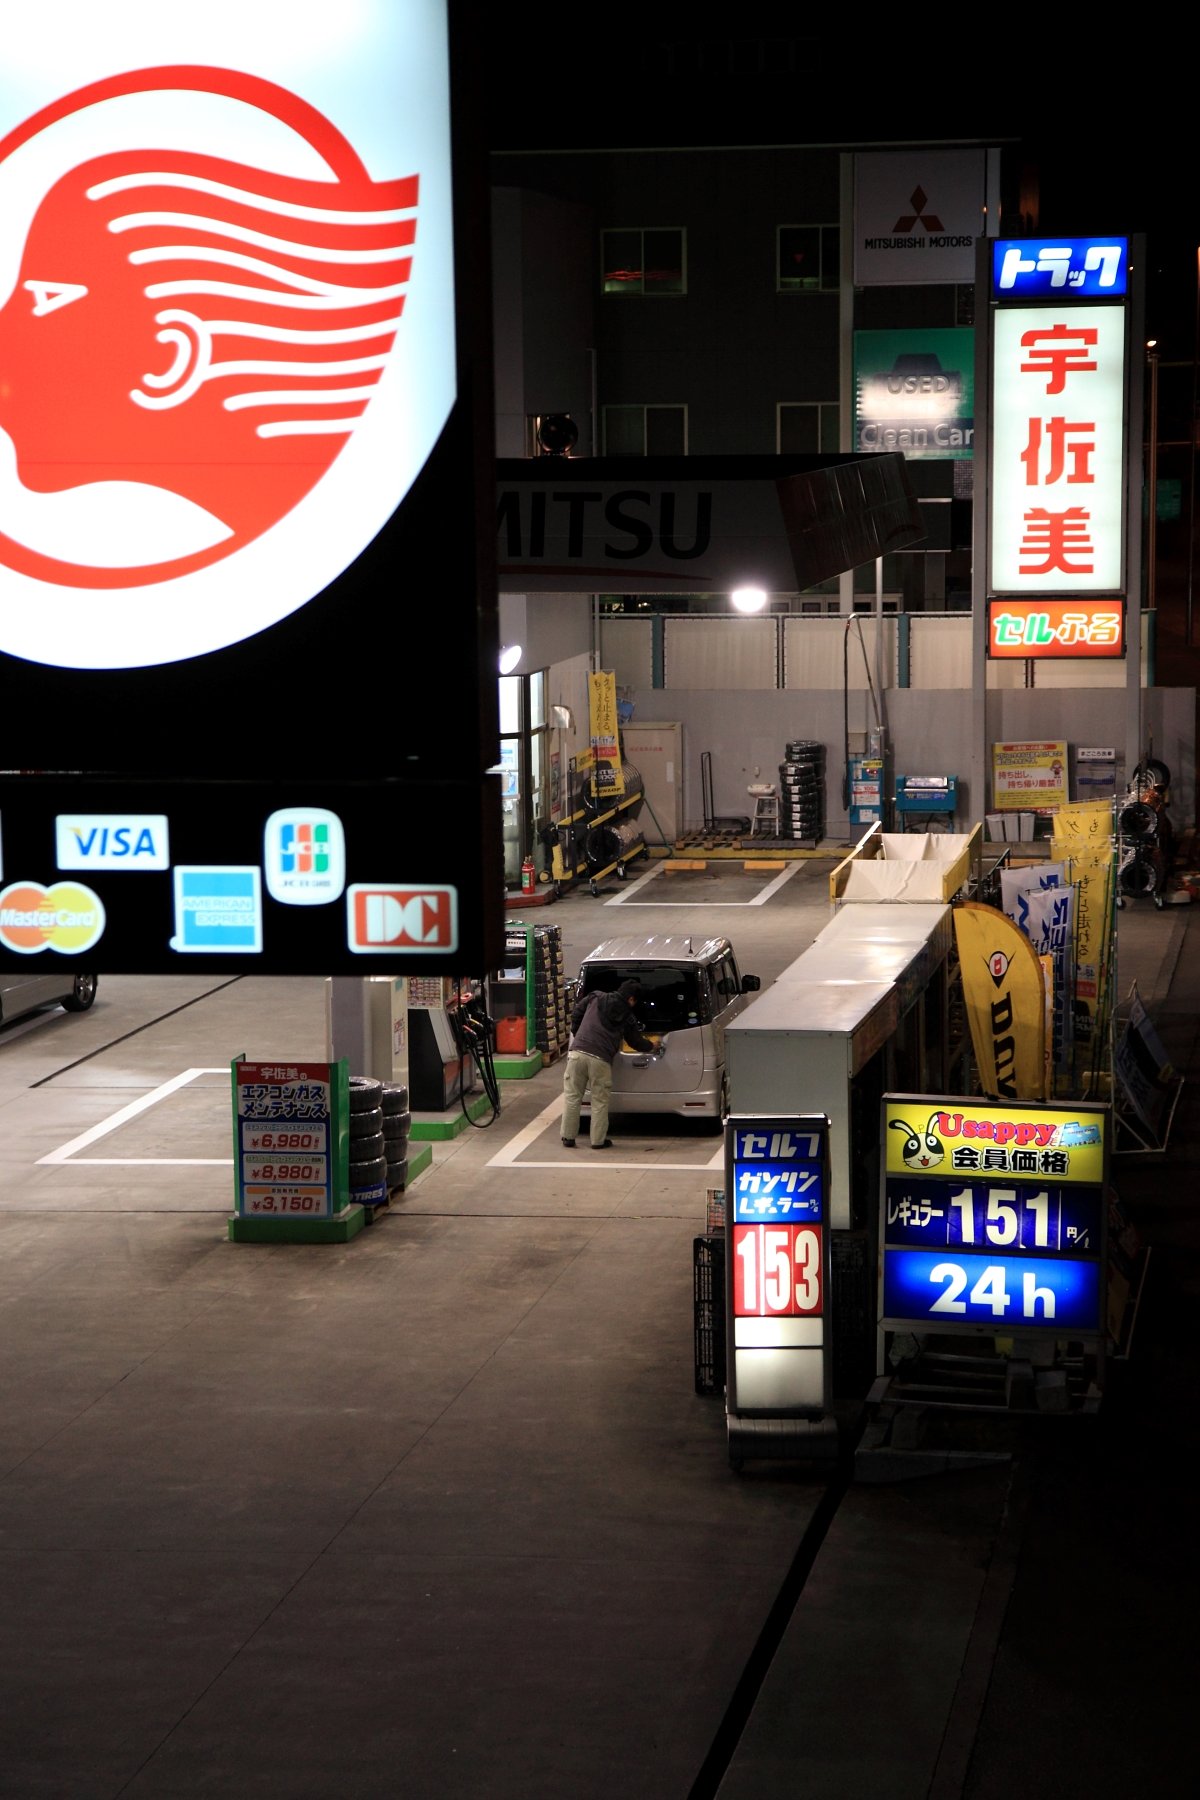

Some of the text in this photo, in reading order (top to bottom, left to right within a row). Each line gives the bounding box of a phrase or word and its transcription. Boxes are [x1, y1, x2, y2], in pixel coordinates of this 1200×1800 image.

[865, 236, 973, 249] MITSUBISHI MOTORS
[999, 246, 1122, 289] トラック
[887, 375, 951, 395] USED
[860, 425, 928, 448] Clean
[1019, 324, 1098, 574] 宇佐美
[993, 613, 1120, 646] セルふる
[70, 827, 157, 857] VISA
[0, 908, 94, 928] MasterCard
[196, 912, 256, 926] EXPRESS
[366, 894, 438, 942] DC
[261, 1067, 308, 1081] 宇佐美の
[242, 1085, 325, 1101] エアコンガス
[244, 1102, 328, 1118] メンテナンス
[938, 1113, 1057, 1147] Usappy
[252, 1134, 313, 1149] ¥6,980
[741, 1133, 820, 1158] セルフ
[953, 1148, 1069, 1174] 会員価格
[252, 1165, 314, 1180] ¥8,980
[739, 1172, 819, 1193] ガソリン
[253, 1197, 314, 1212] ¥3,150
[355, 1188, 384, 1201] TIRES
[739, 1197, 808, 1215] レギュラー
[888, 1196, 944, 1227] レギュラー
[951, 1188, 1049, 1246] 151
[737, 1230, 820, 1311] 153
